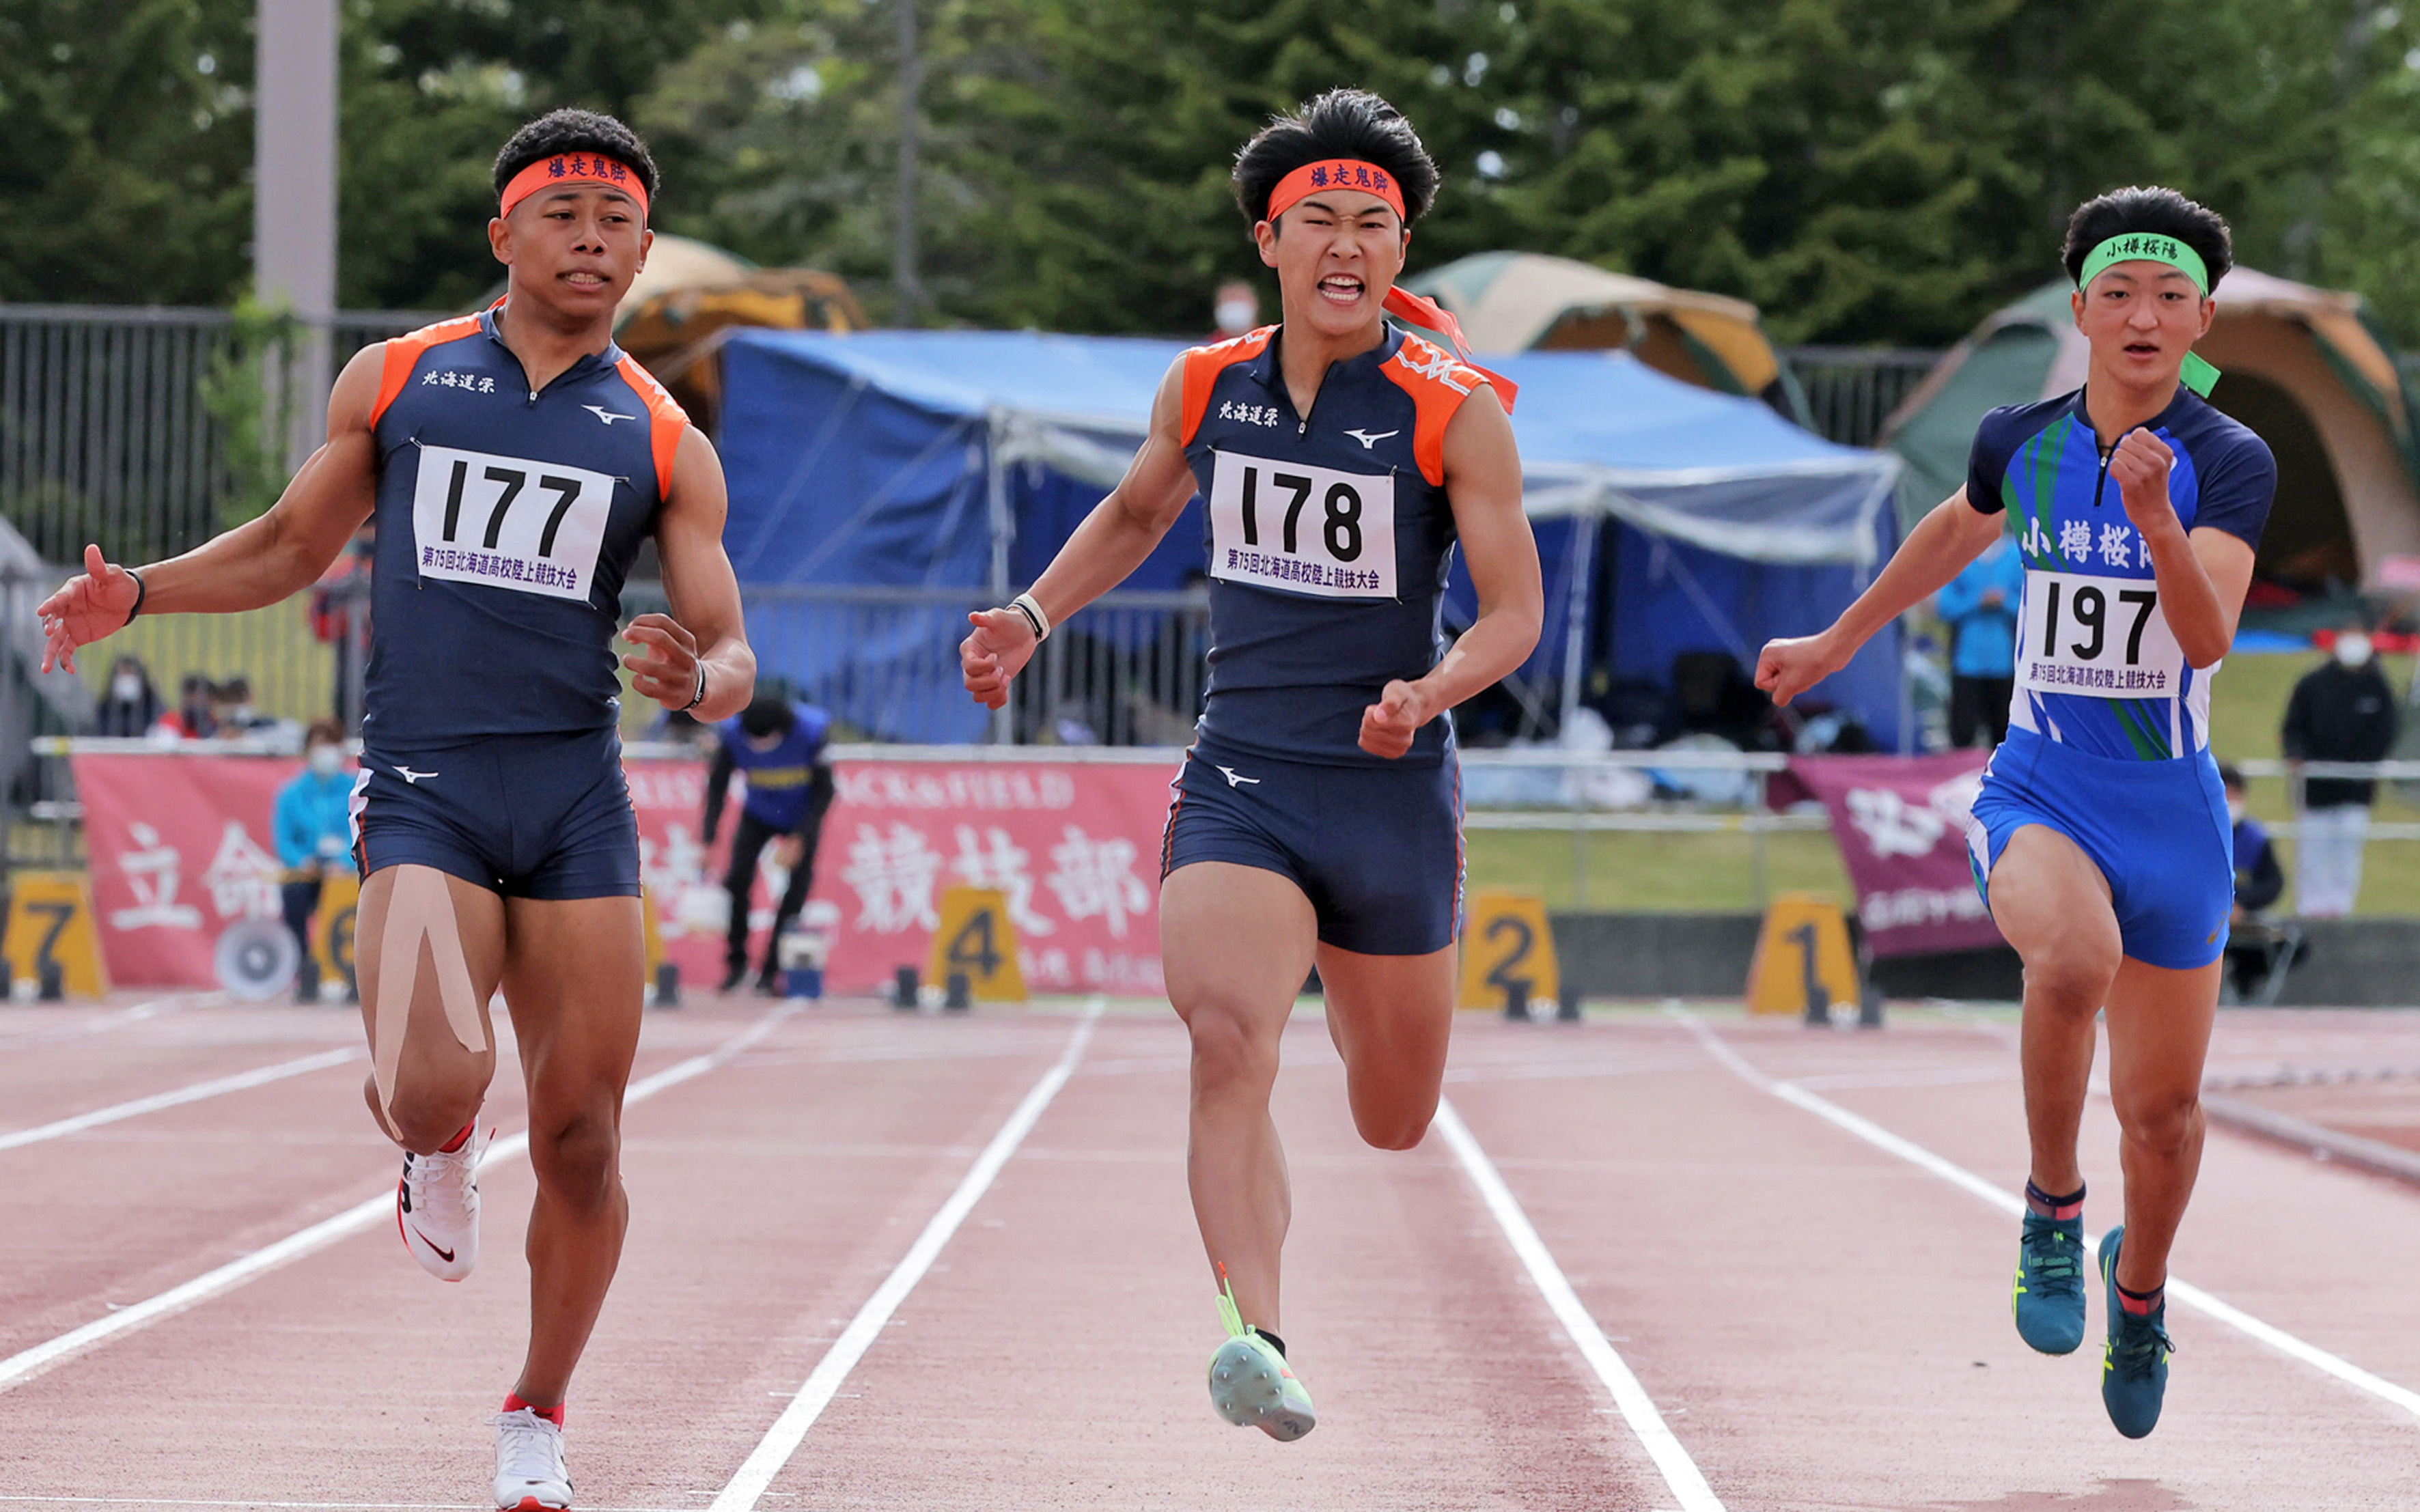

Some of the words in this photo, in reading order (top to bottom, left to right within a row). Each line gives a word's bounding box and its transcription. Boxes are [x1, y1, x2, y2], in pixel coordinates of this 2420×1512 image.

[2106, 238, 2178, 260] 小樽桜陽
[421, 370, 495, 394] 北海道栄
[1219, 400, 1278, 428] 北海道栄
[443, 460, 582, 558] 177
[1242, 466, 1363, 563] 178
[422, 545, 577, 590] 第75回北海道高校陸上競技大会
[1227, 547, 1380, 589] 第75回北海道高校陸上競技大会
[2044, 582, 2157, 665] 197
[2029, 662, 2166, 690] 第75回北海道高校陸上競技大会
[26, 900, 75, 973] 7
[947, 908, 1004, 981] 4
[1484, 915, 1534, 988] 2
[1783, 922, 1818, 994] 1
